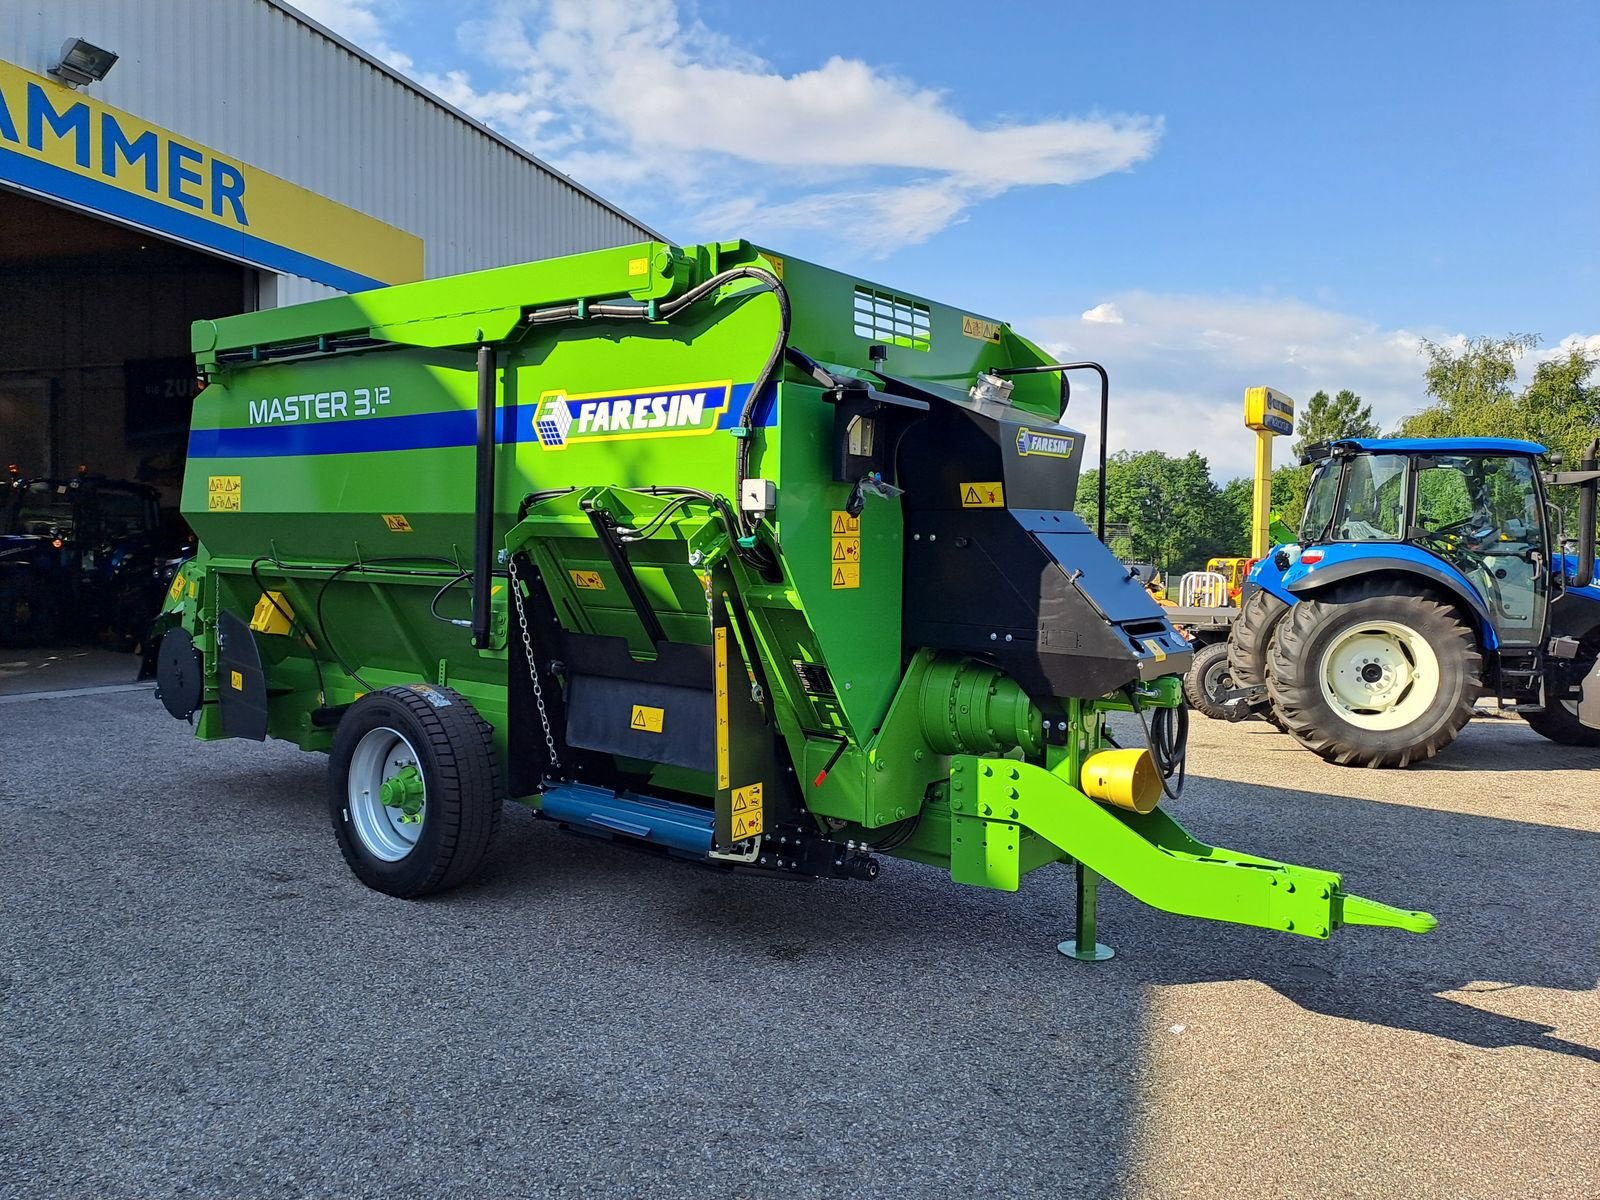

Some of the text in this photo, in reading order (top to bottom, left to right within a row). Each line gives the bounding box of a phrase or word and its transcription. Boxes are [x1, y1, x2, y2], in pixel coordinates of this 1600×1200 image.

[165, 378, 193, 398] ZU
[249, 391, 349, 425] MASTER
[577, 392, 706, 434] FARESIN
[1031, 436, 1068, 454] FARESIN
